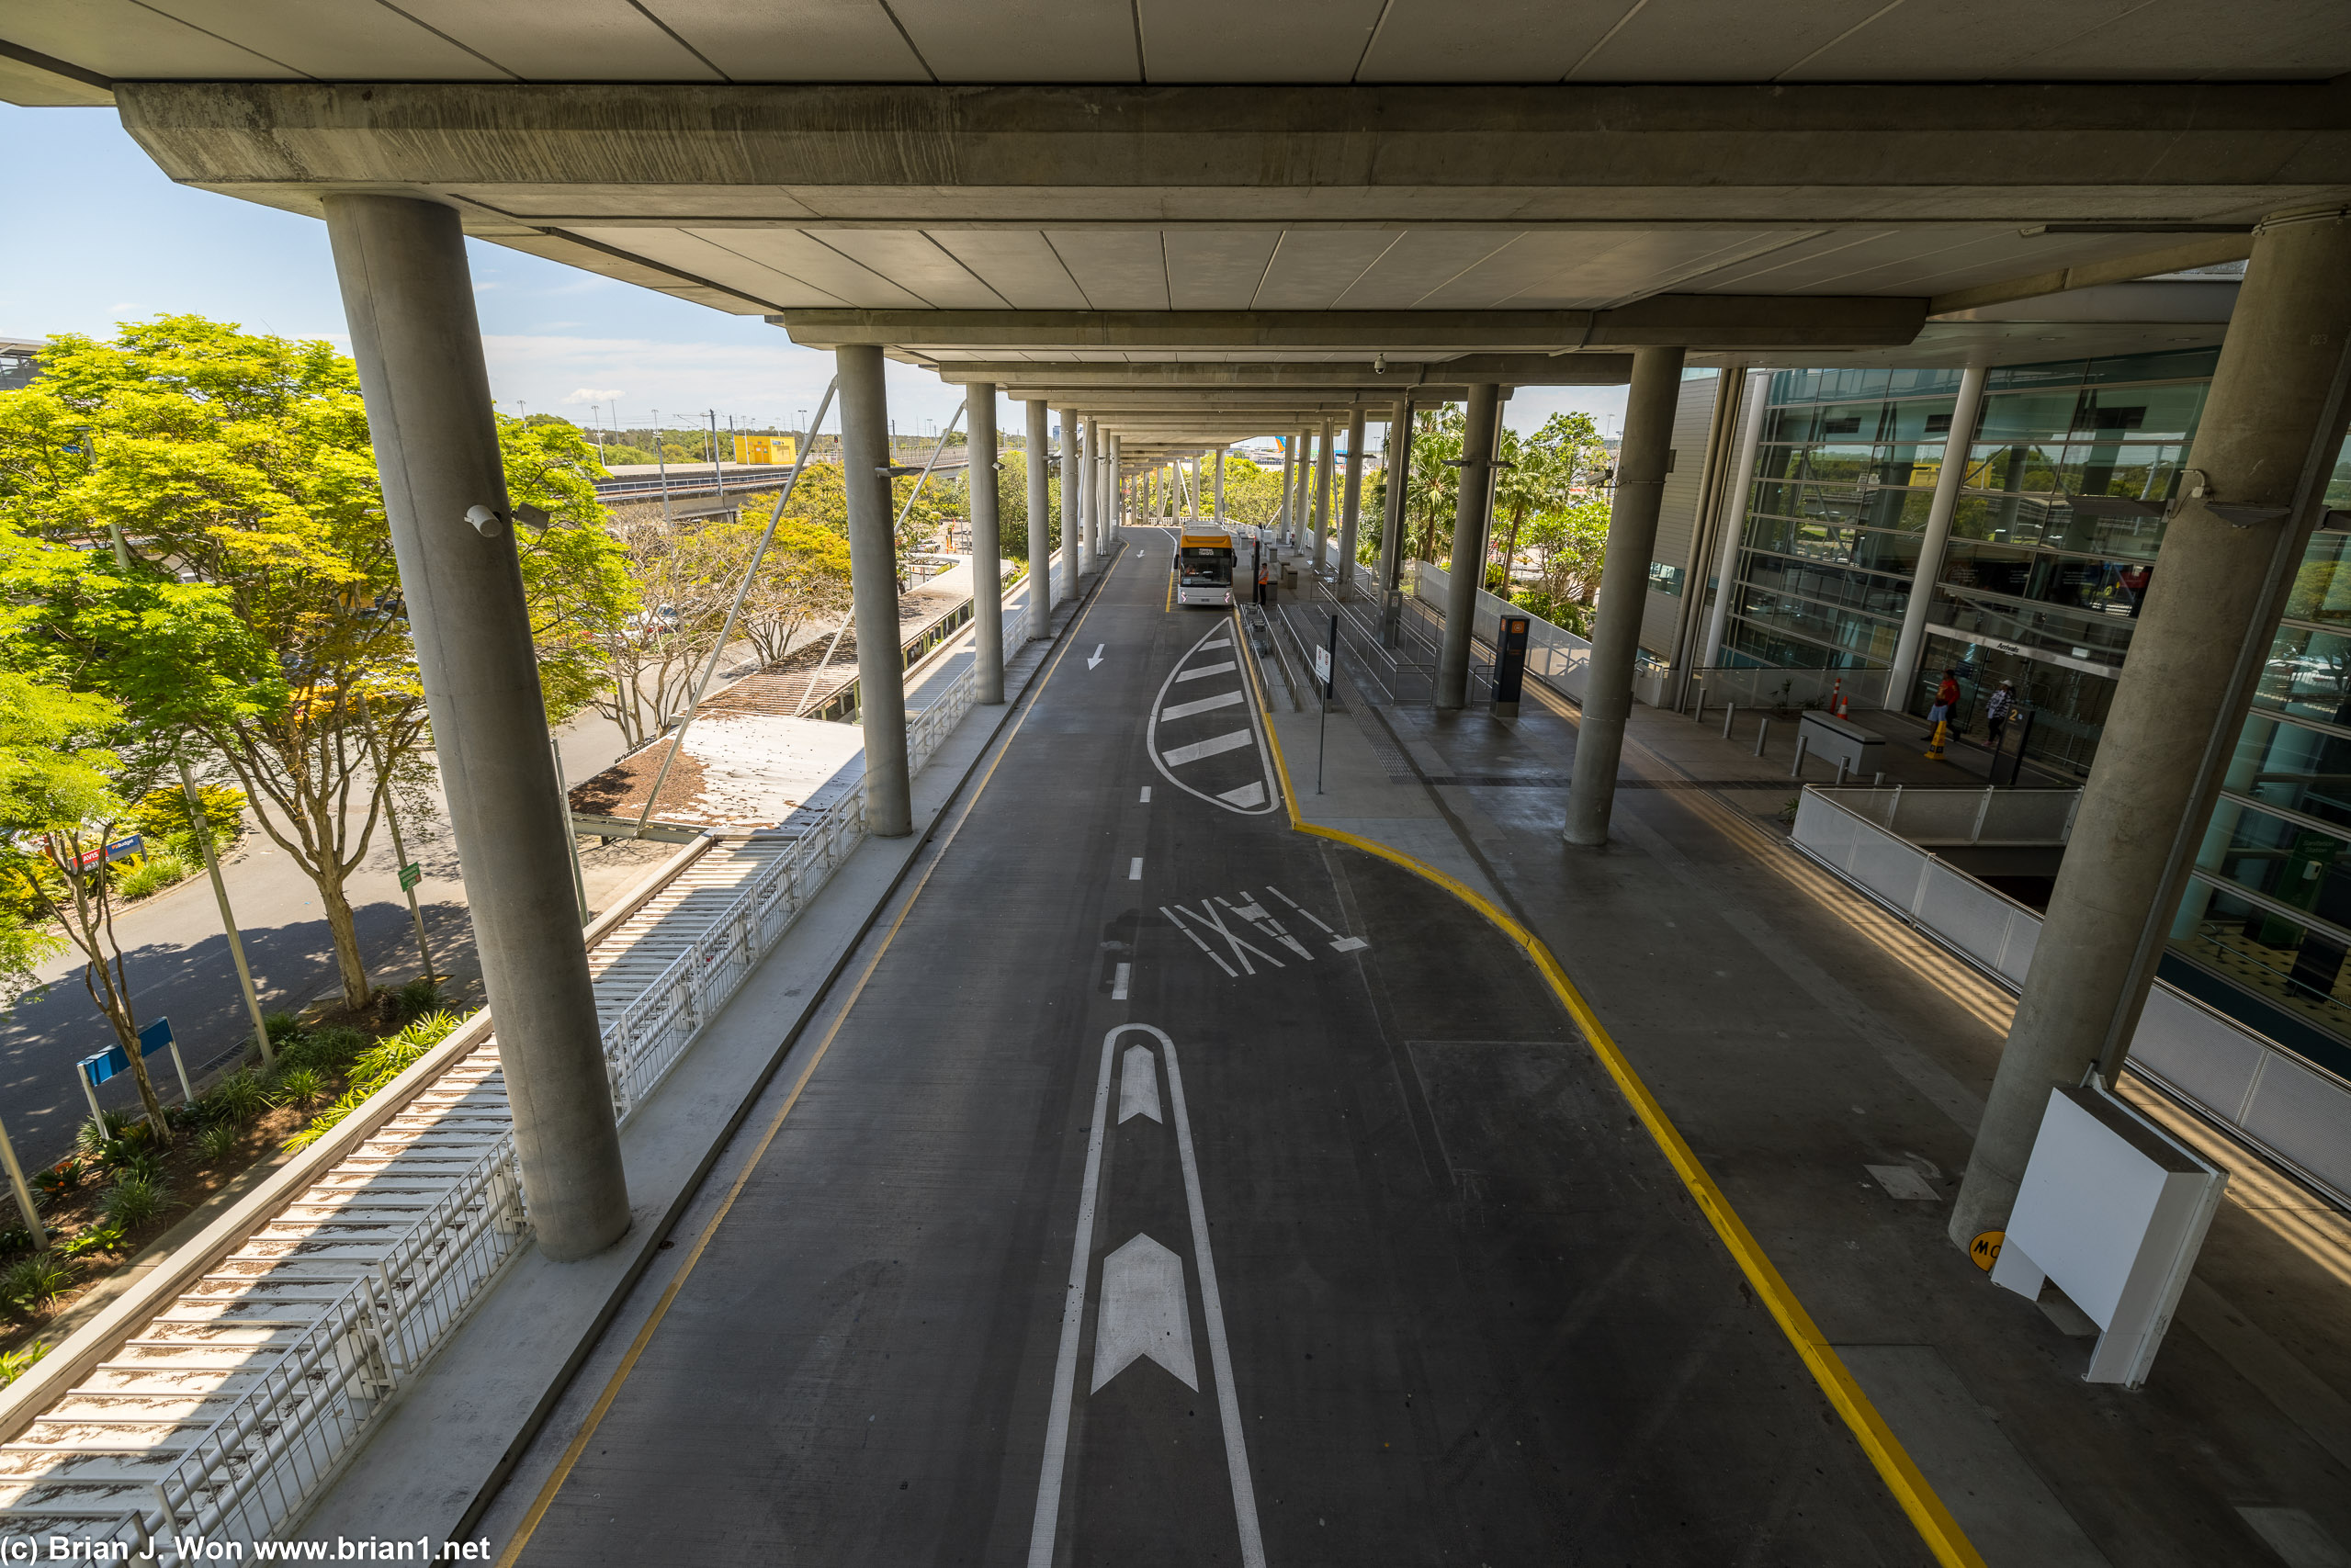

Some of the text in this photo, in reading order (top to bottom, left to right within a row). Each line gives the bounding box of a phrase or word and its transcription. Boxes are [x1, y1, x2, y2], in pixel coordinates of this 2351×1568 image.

[1997, 643, 2019, 653] Arrivals
[2008, 708, 2018, 721] 2
[118, 839, 134, 847] Budget
[83, 852, 99, 862] AVIS
[1159, 886, 1368, 977] TAXI
